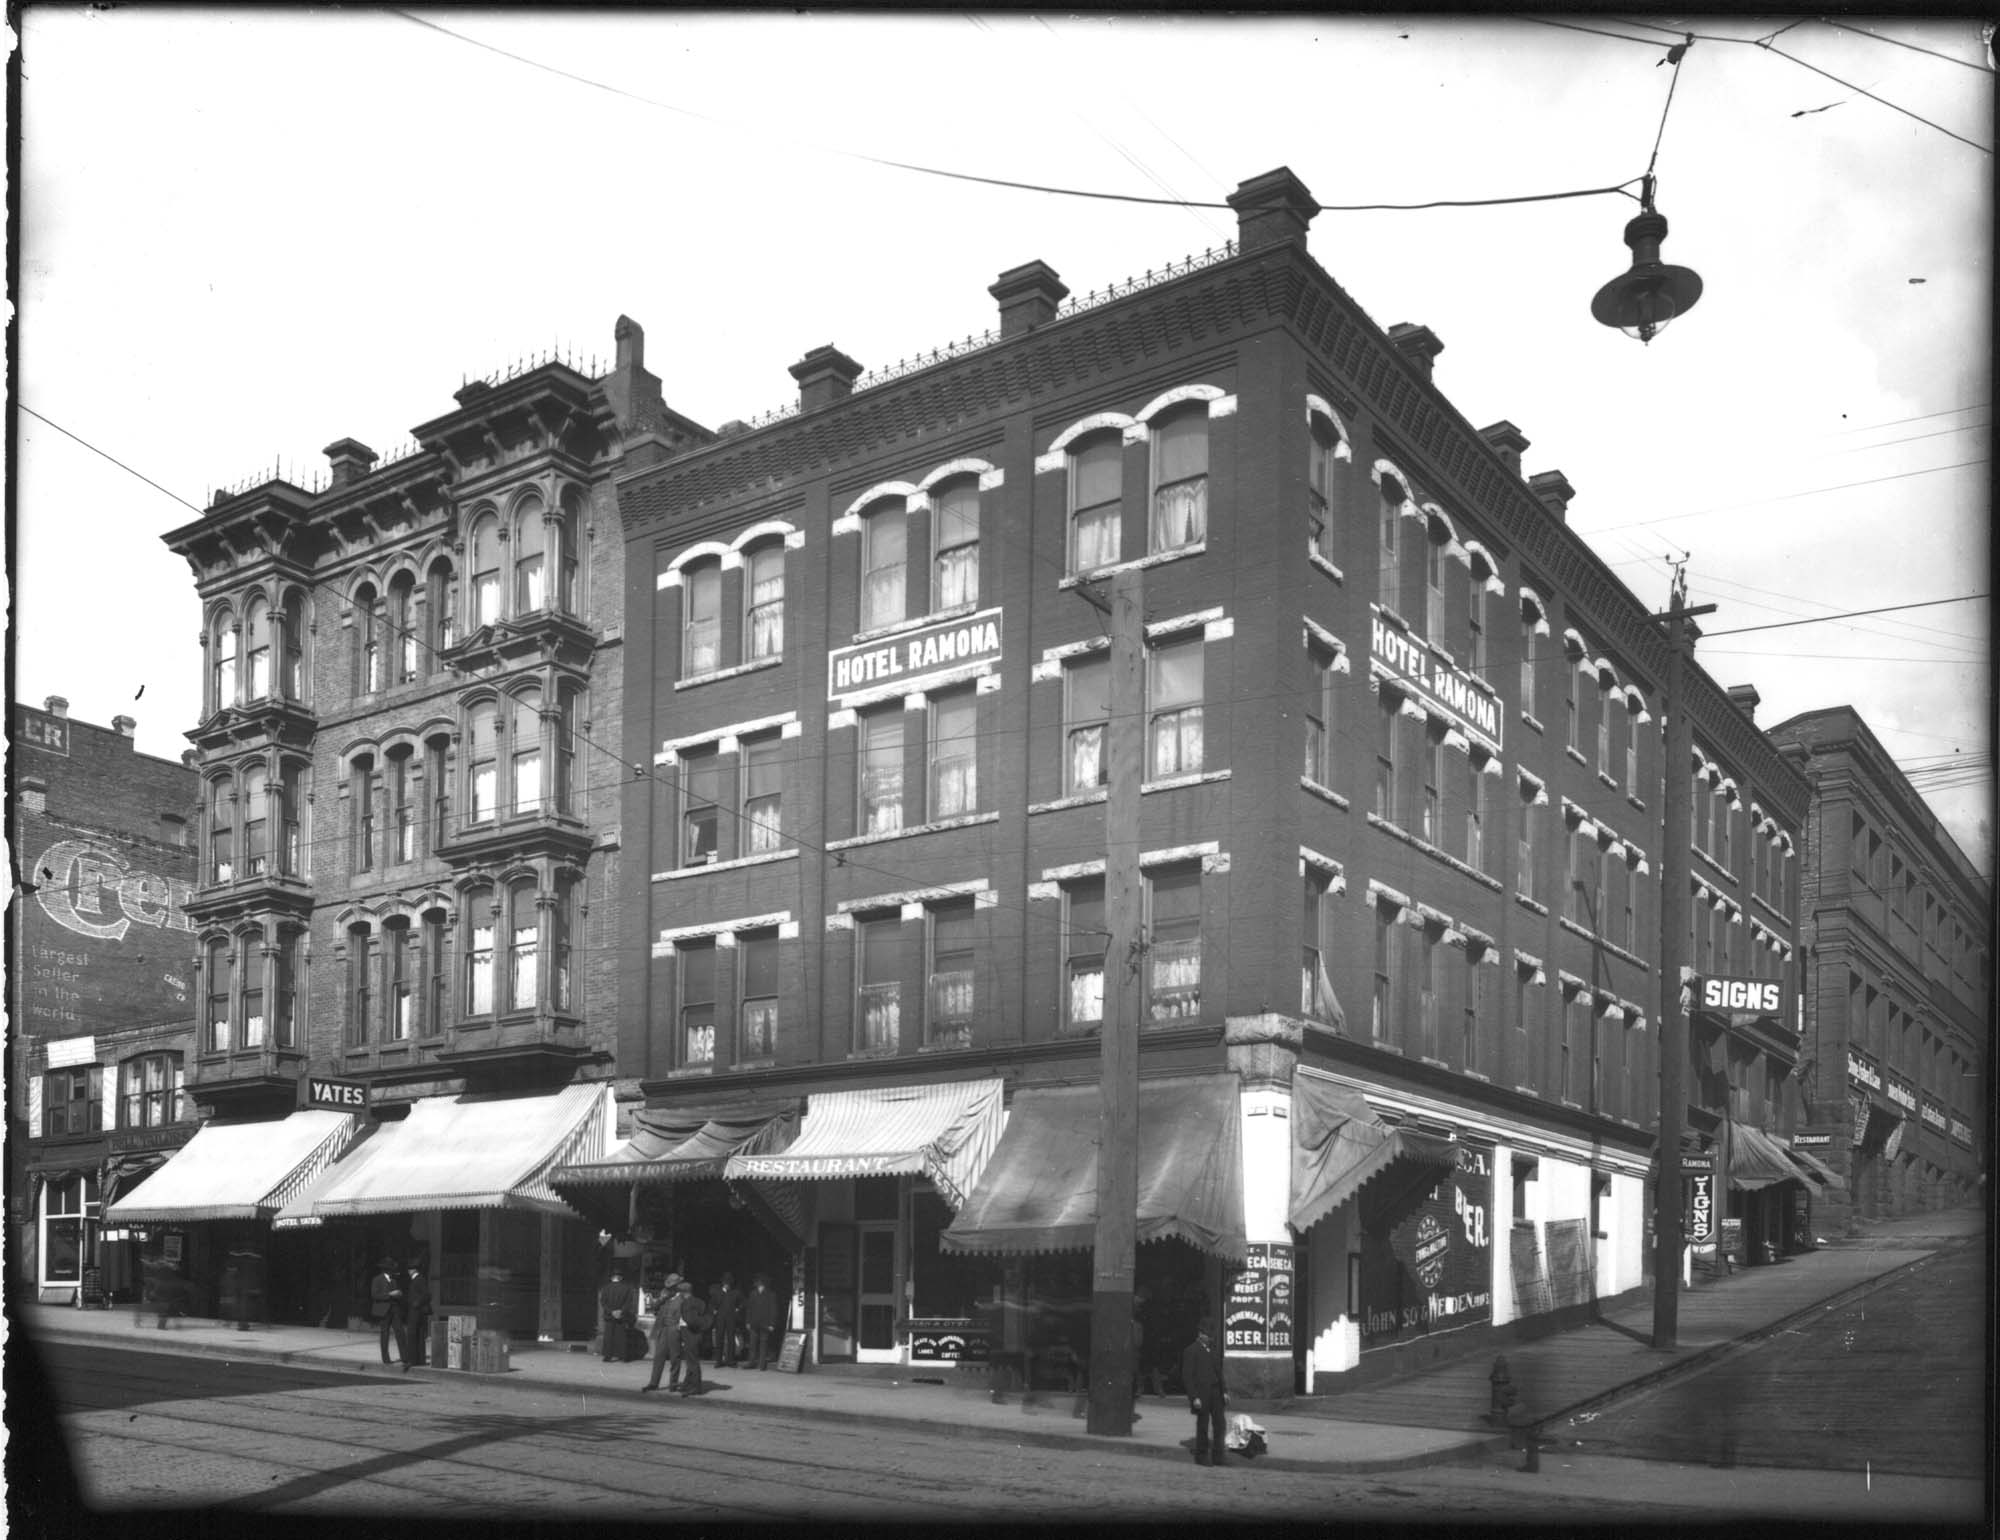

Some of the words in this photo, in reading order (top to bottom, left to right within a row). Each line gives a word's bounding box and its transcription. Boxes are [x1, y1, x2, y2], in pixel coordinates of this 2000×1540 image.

[837, 646, 903, 688] HOTEL
[909, 621, 999, 670] RAMONA
[1372, 618, 1431, 688] HOTEL
[1435, 664, 1497, 737] RAMONA
[15, 717, 63, 749] ER
[31, 943, 89, 967] Largest
[33, 964, 80, 983] Seller
[55, 987, 80, 1002] the
[1705, 979, 1779, 1011] SIGNS
[1681, 1158, 1711, 1168] RAMONA
[1247, 1256, 1267, 1269] ECA
